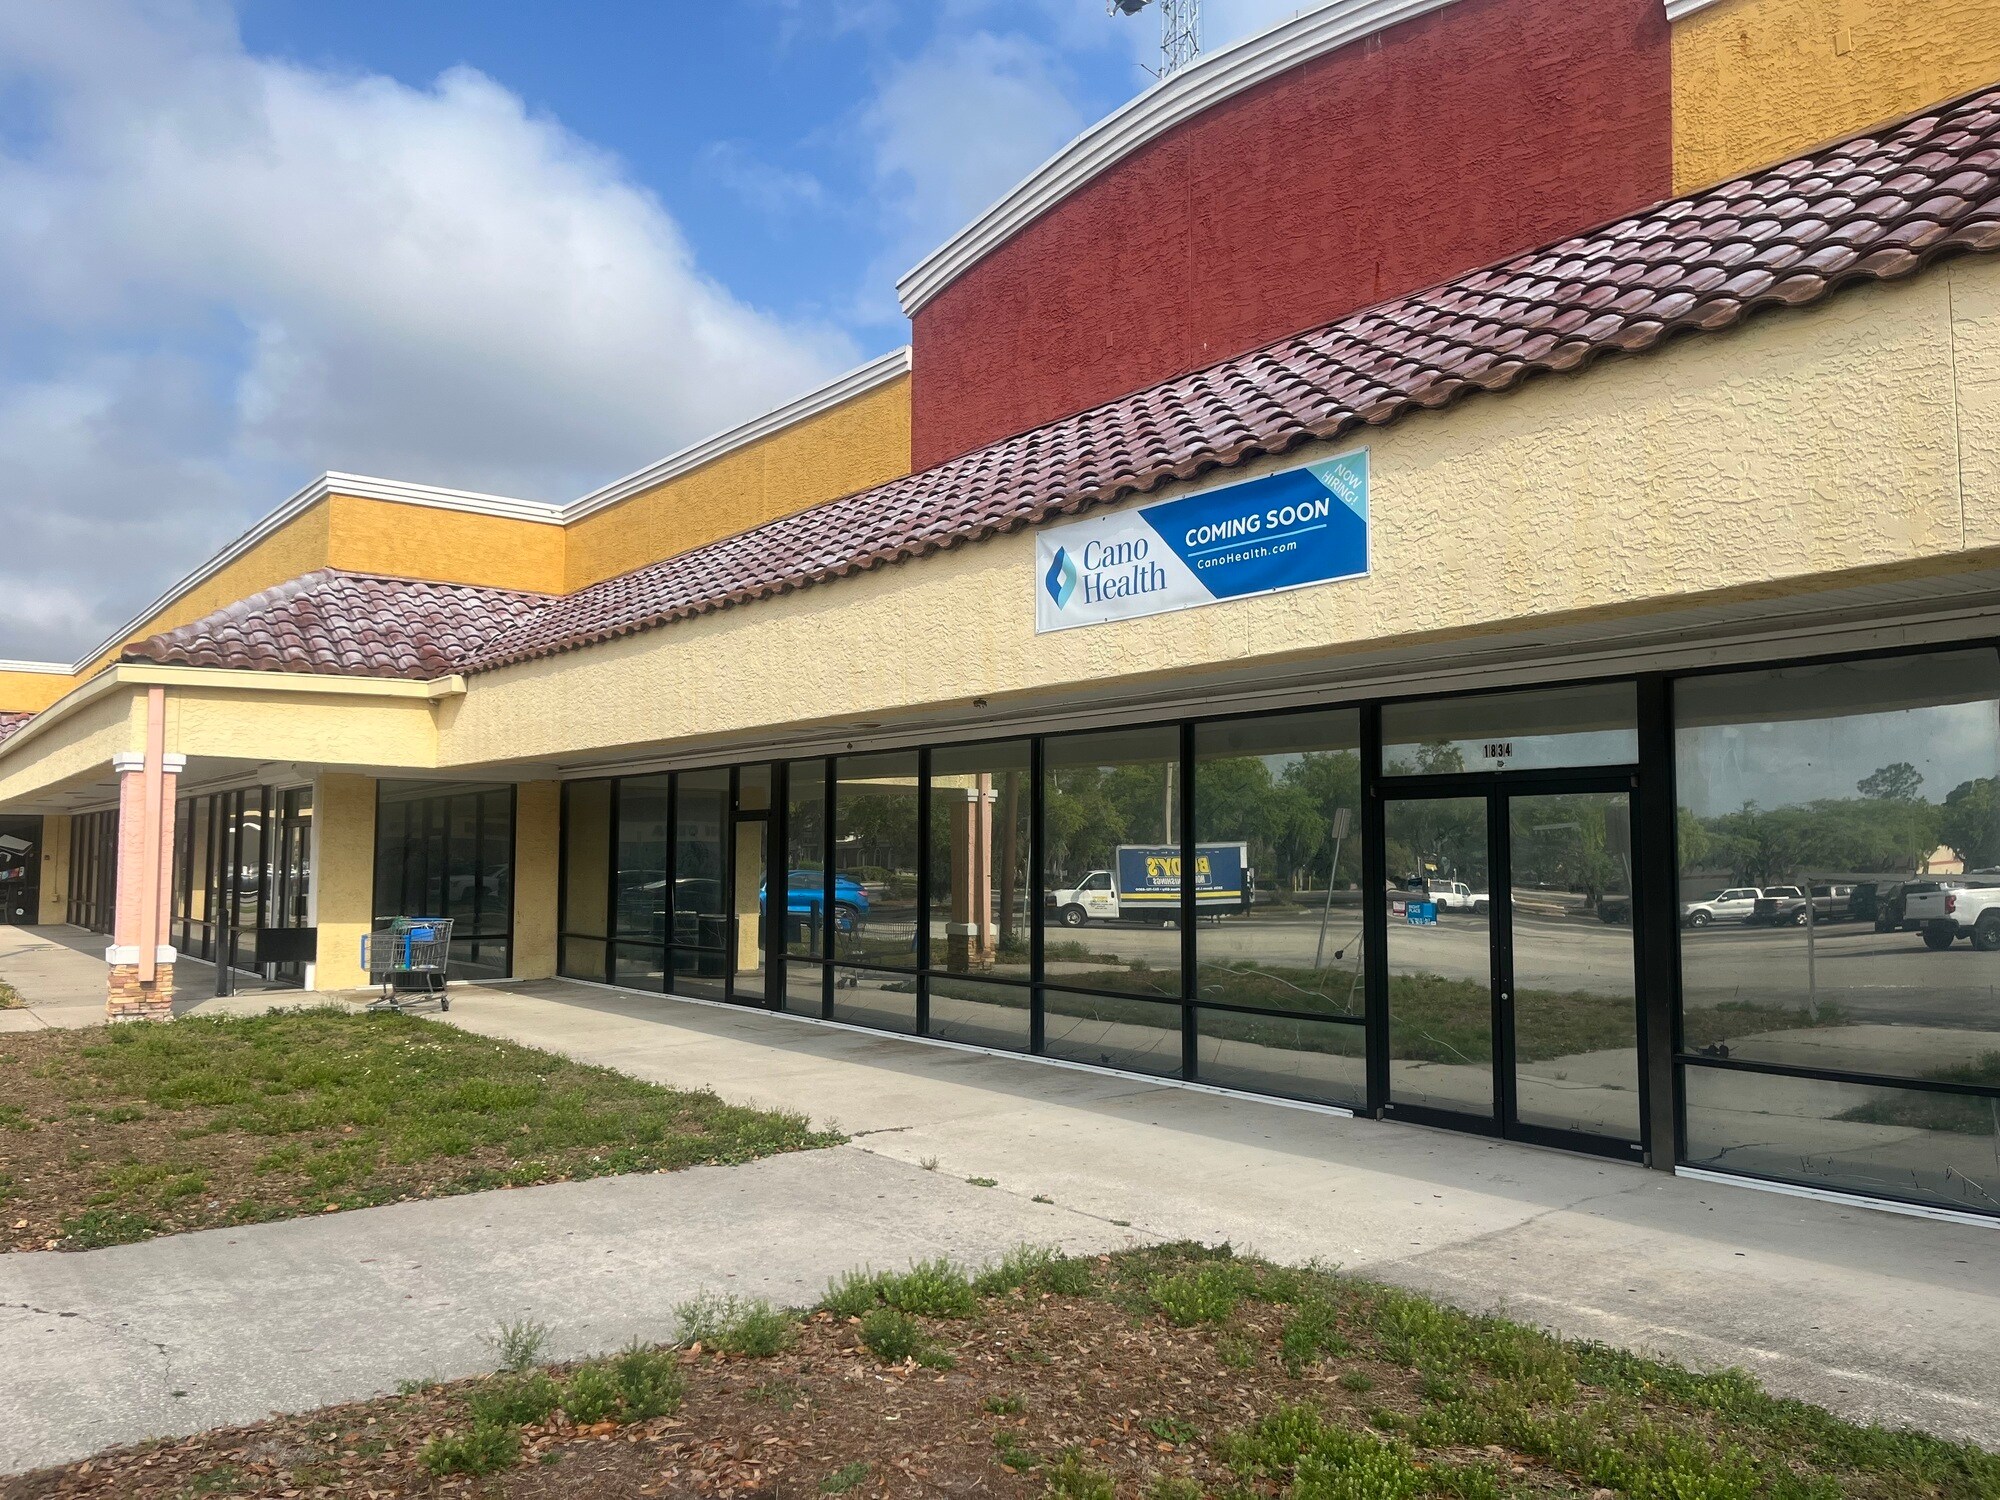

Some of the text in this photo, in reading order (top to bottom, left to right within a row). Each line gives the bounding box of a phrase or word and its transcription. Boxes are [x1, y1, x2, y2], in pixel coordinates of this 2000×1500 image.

[1321, 470, 1358, 506] HIRING!
[1334, 463, 1362, 489] NOW
[1185, 497, 1330, 548] COMING SOON
[1083, 537, 1149, 571] Cano
[1197, 540, 1298, 570] CanoHealth.com
[1082, 561, 1167, 605] Health
[1484, 742, 1511, 758] 1834
